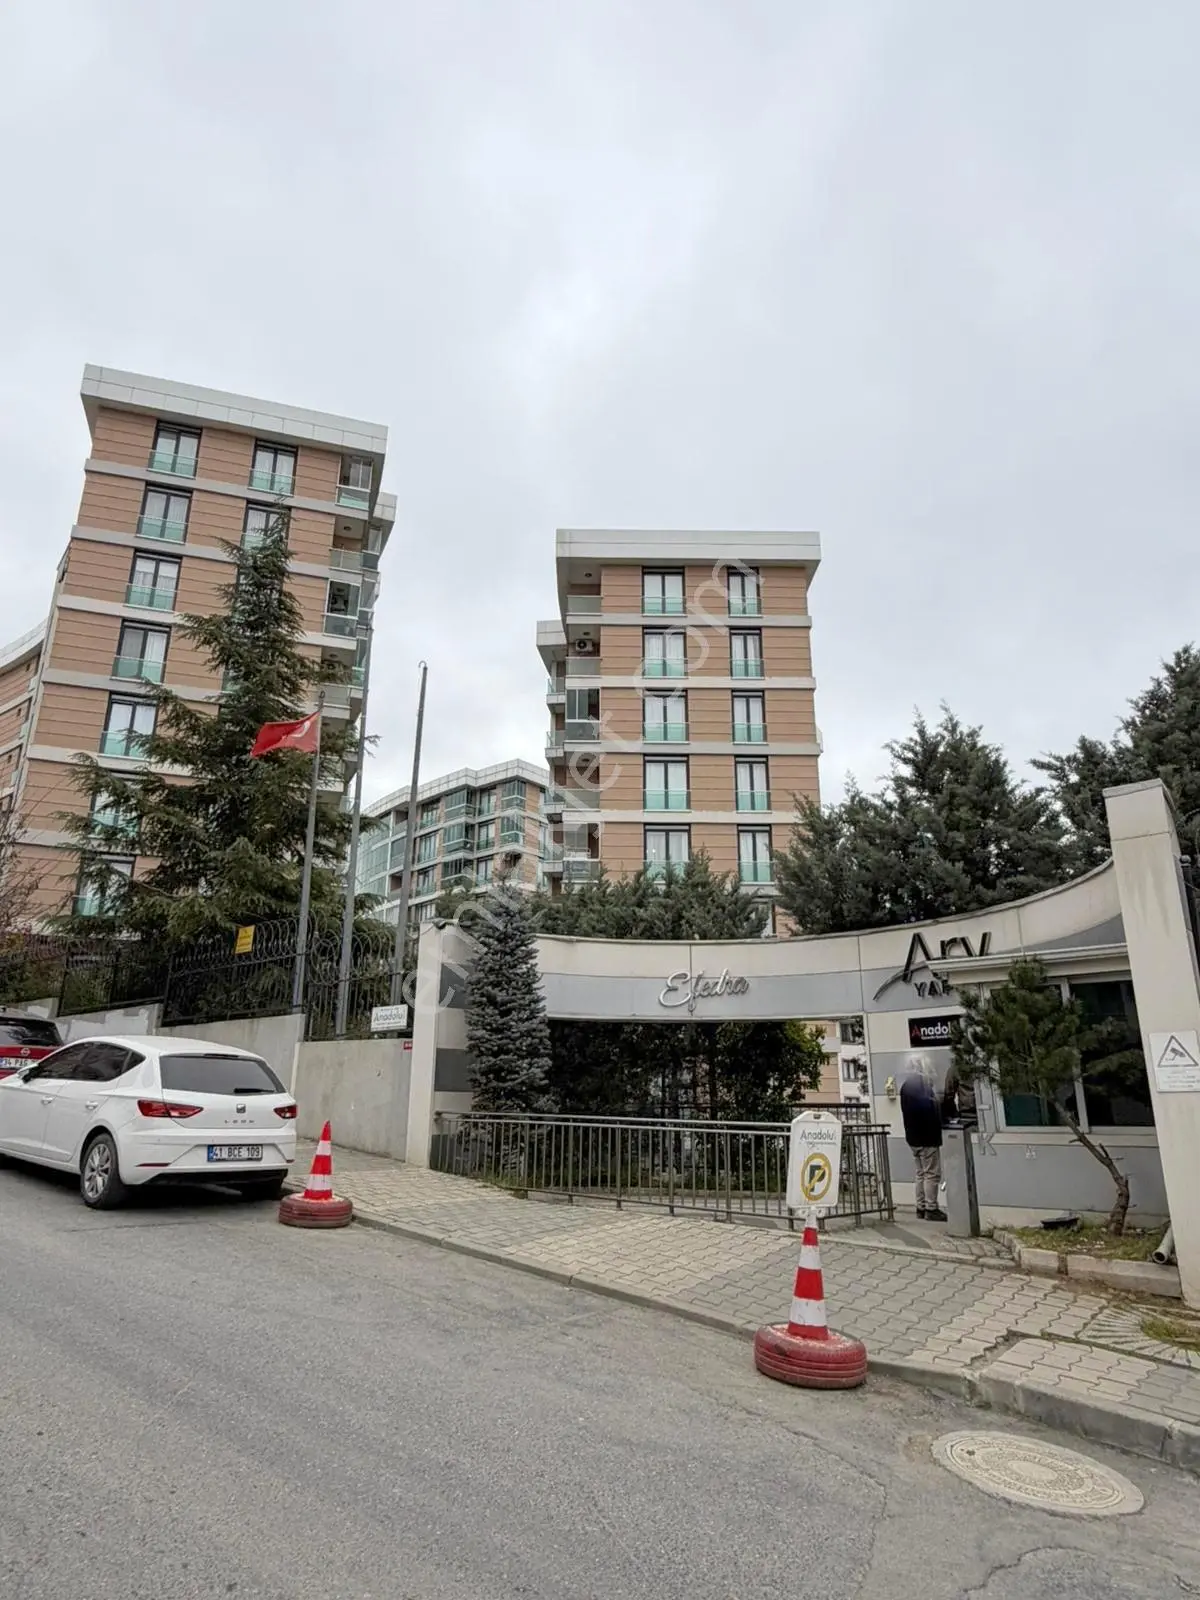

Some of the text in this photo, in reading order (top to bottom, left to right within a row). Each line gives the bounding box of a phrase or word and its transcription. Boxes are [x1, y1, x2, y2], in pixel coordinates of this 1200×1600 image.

[659, 968, 749, 1016] Efedra
[911, 1021, 953, 1037] Anadol
[799, 1128, 834, 1141] Anadolu
[214, 1146, 260, 1157] 41 BCE 109
